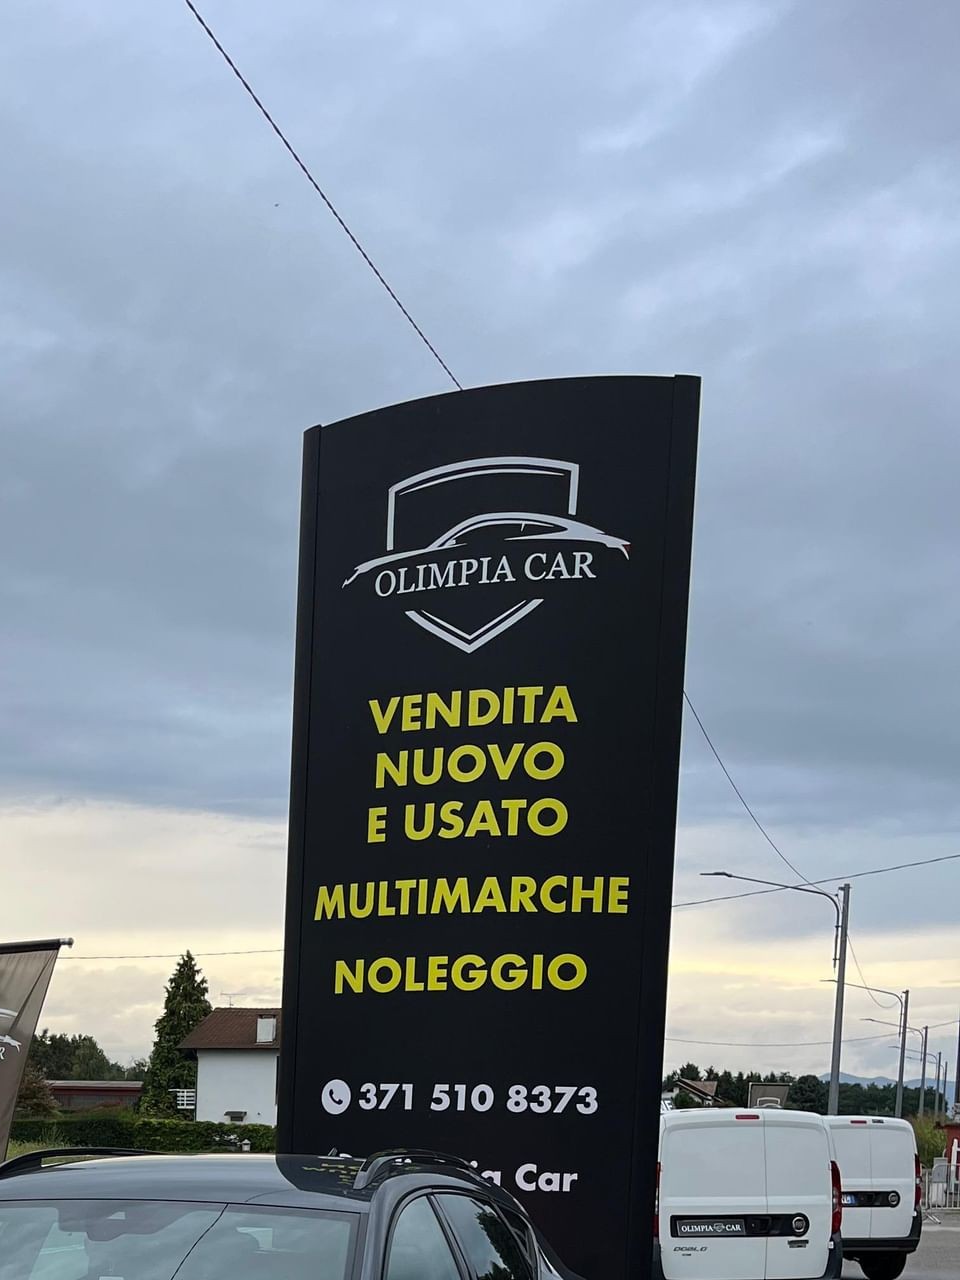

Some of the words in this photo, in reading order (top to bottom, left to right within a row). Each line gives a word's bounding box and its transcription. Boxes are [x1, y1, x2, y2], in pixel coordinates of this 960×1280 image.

[374, 555, 516, 598] OLIMPIA
[524, 551, 596, 581] CAR
[368, 685, 578, 735] VENDITA
[375, 741, 565, 789] NUOVO
[367, 806, 388, 843] E
[404, 797, 569, 841] USATO
[313, 875, 630, 921] MULTIMARCHE
[334, 953, 588, 994] NOLEGGIO
[358, 1082, 414, 1111] 371
[430, 1083, 495, 1112] 510
[506, 1084, 599, 1115] 8373
[514, 1163, 578, 1192] Car
[681, 1224, 714, 1233] OLIMPIA
[725, 1223, 742, 1231] CAR
